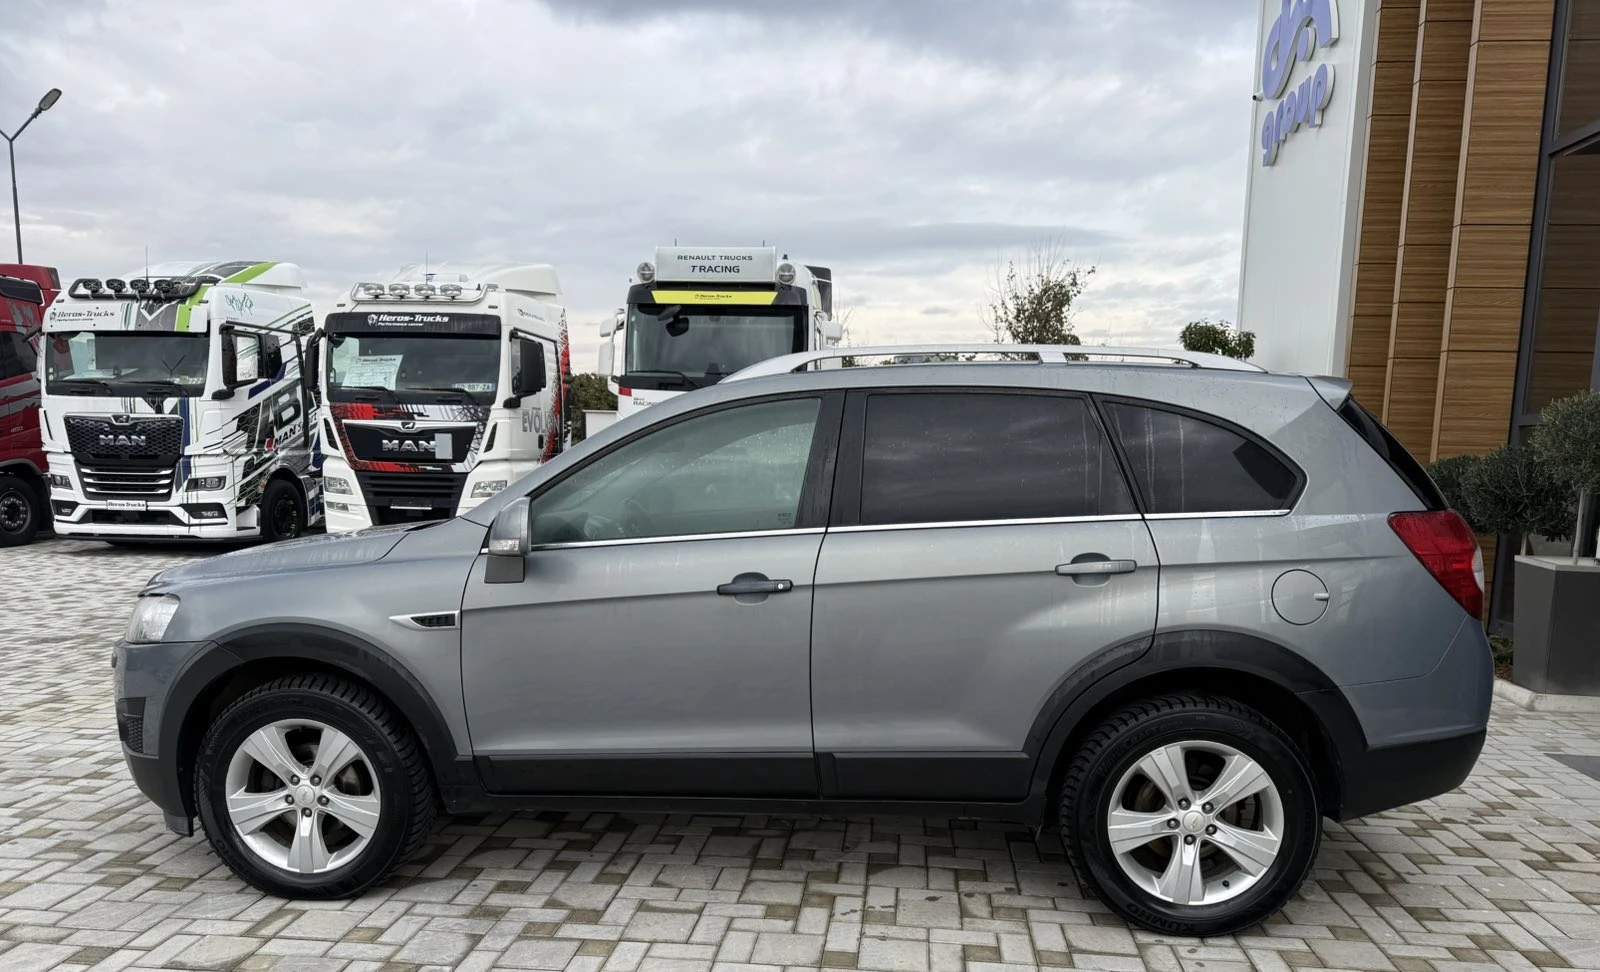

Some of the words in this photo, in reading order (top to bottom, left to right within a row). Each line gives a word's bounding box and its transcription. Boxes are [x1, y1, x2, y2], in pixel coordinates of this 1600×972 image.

[1261, 64, 1334, 167] group
[698, 265, 741, 274] RACING
[57, 310, 115, 318] Heros-Trucks
[378, 313, 450, 323] Heros-Trucks
[99, 434, 146, 446] MAN
[382, 439, 436, 452] MAN
